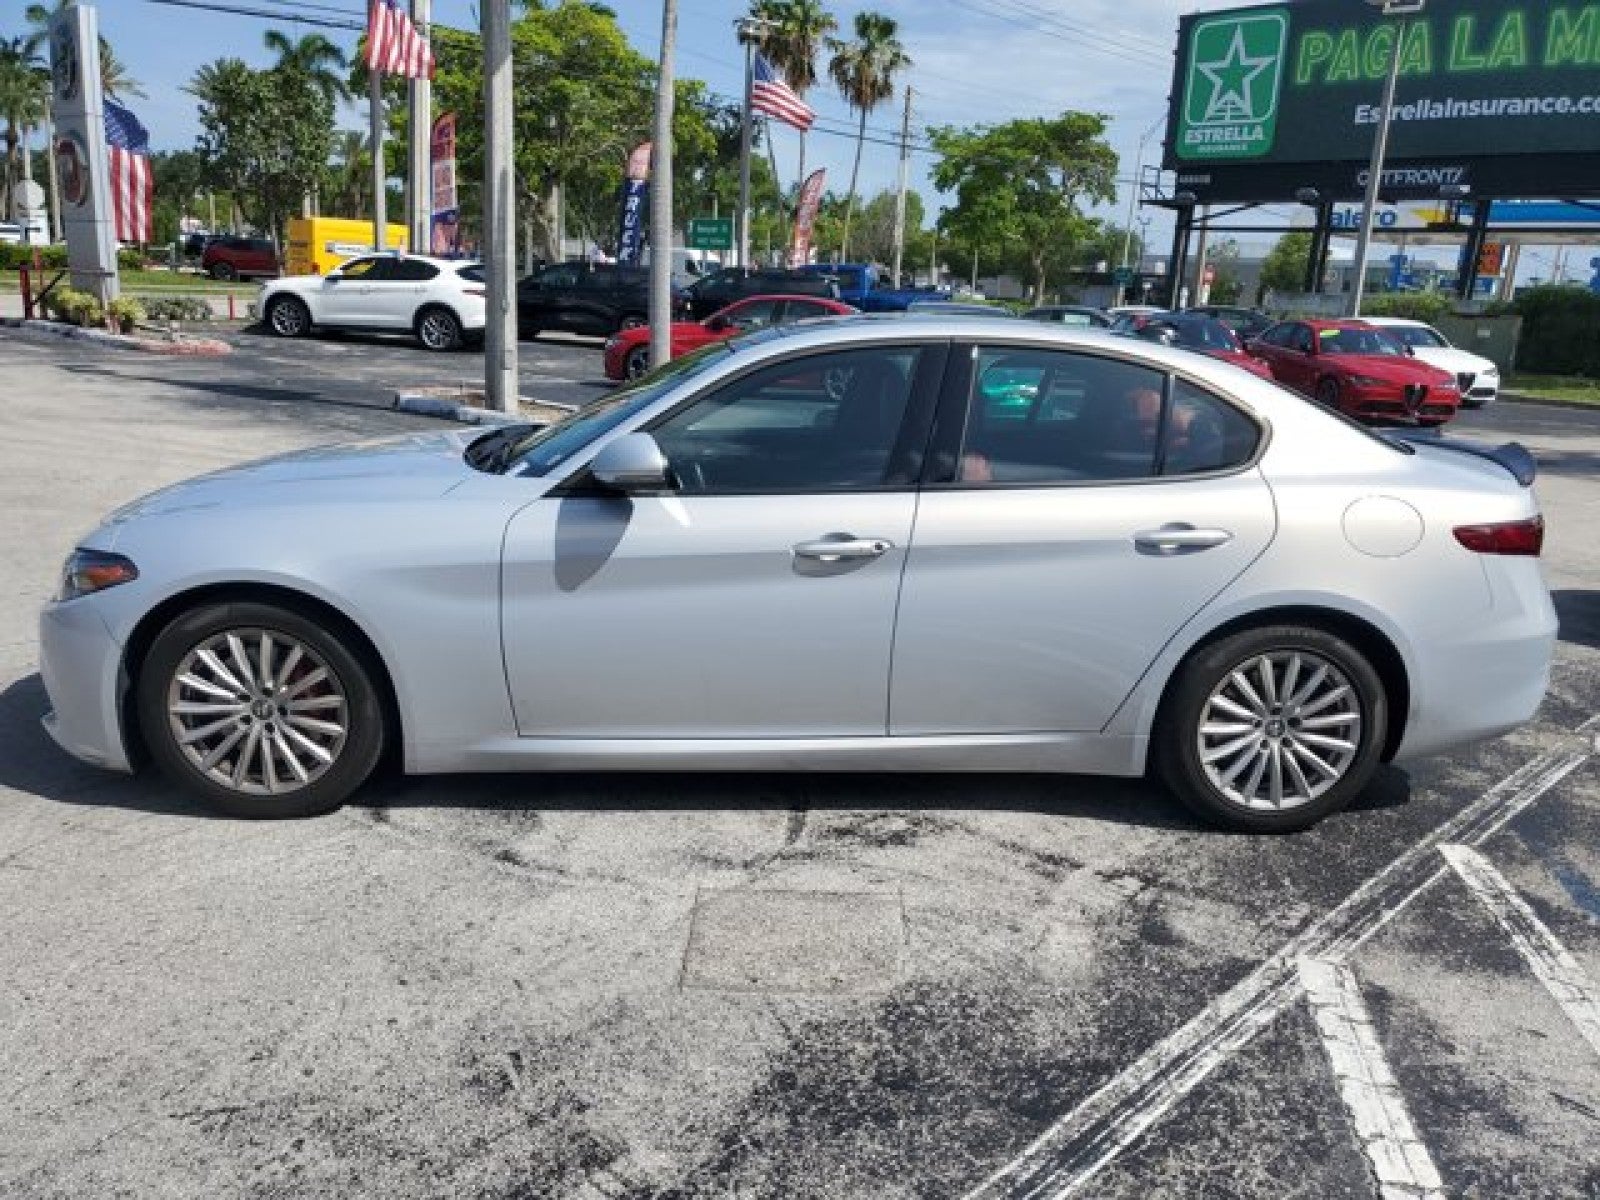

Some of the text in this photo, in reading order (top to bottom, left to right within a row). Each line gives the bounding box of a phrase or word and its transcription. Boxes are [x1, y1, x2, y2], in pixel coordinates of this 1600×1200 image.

[1297, 6, 1600, 84] PAGA LA M
[1354, 96, 1600, 125] EsrellaInsurance.c
[1184, 125, 1264, 145] ESTRELLA
